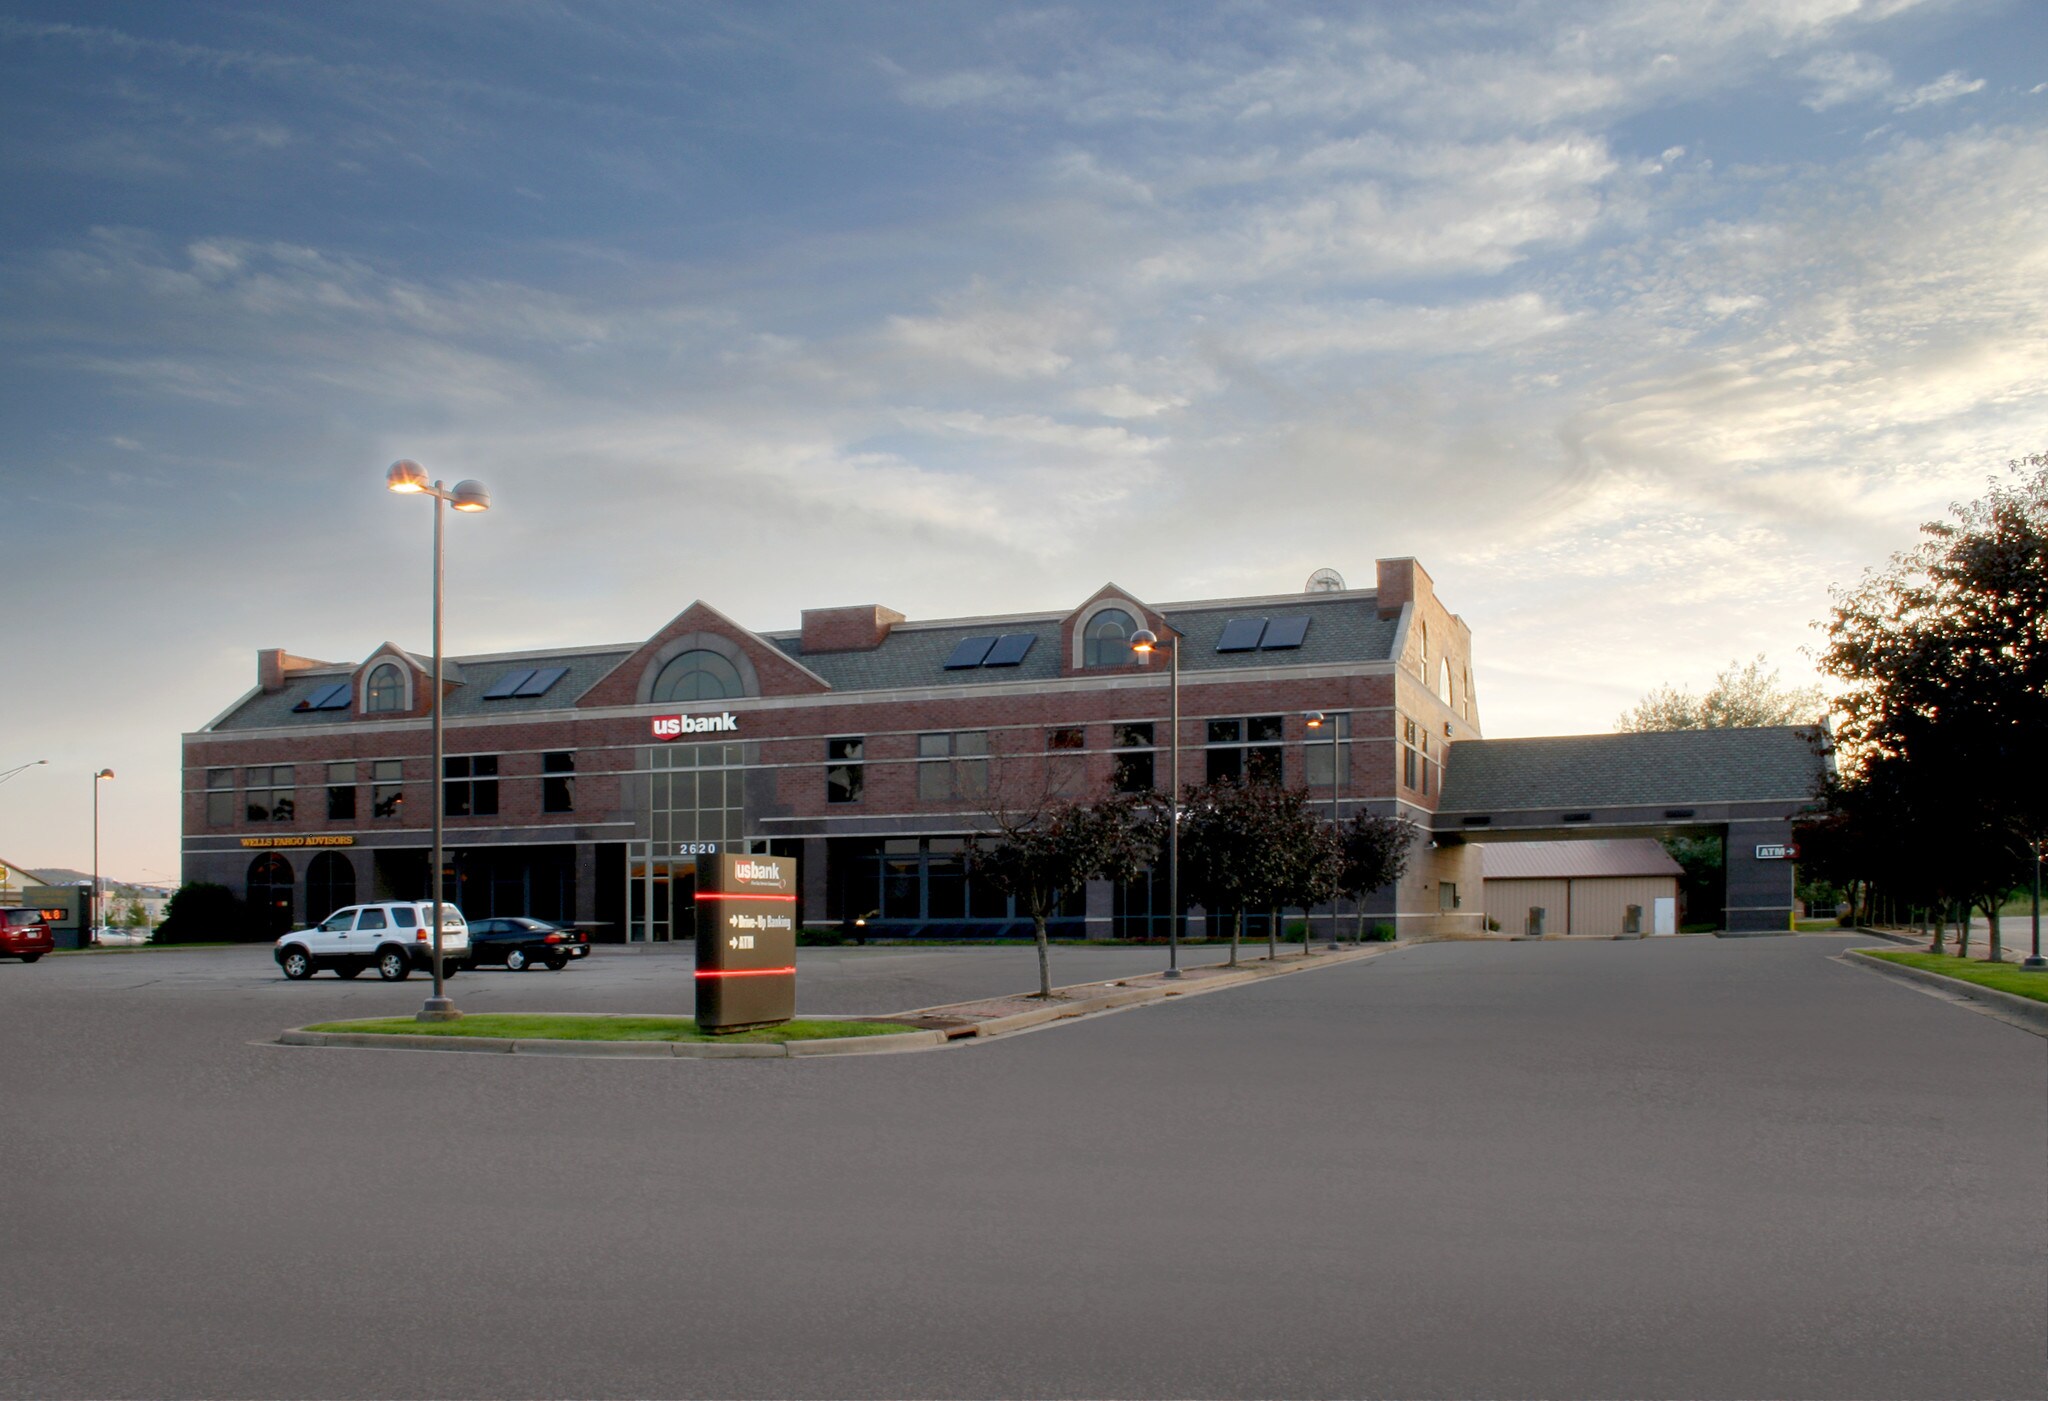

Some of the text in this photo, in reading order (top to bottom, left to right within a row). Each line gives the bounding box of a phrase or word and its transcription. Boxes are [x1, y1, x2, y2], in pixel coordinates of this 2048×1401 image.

[241, 836, 353, 847] WELLS FARGO ADVISORS
[680, 843, 716, 855] 2620
[1761, 847, 1786, 856] ATM
